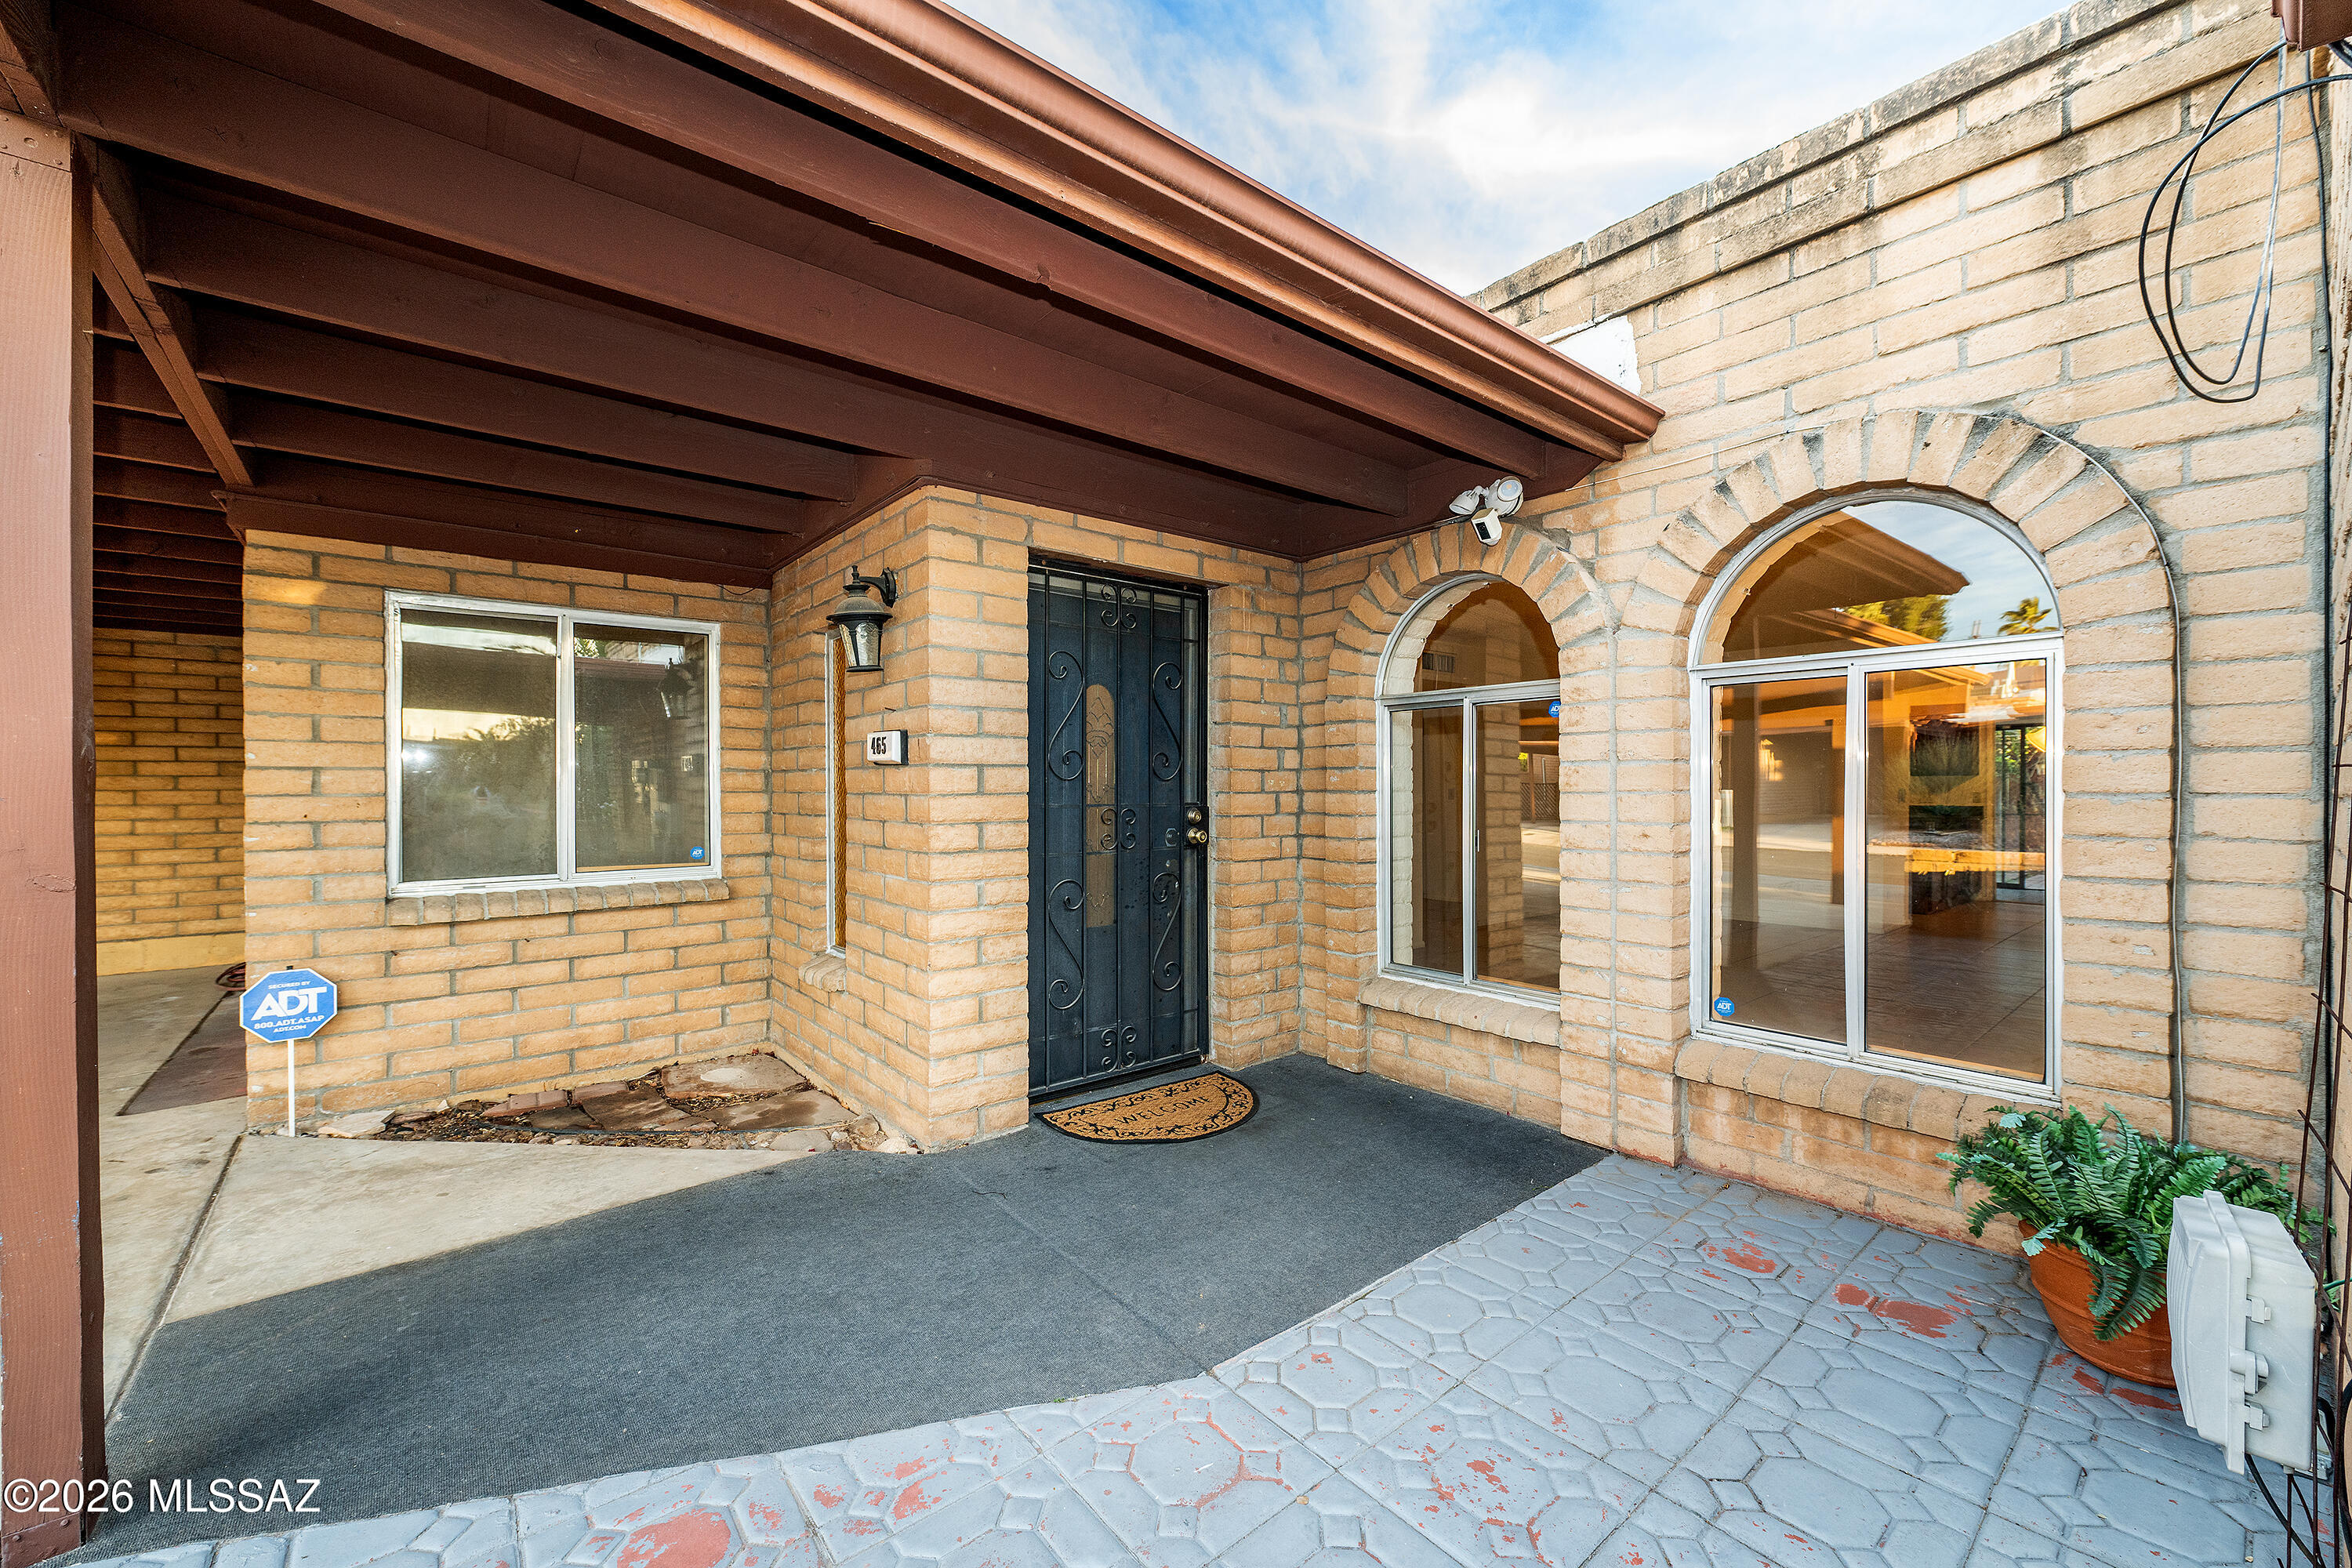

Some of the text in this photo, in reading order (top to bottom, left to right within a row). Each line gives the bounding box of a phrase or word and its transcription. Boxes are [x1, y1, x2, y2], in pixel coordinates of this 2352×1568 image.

[871, 736, 887, 754] 465
[251, 986, 327, 1021] ADT
[253, 1015, 325, 1029] 800.ADT.ASAP
[1114, 1095, 1212, 1124] WELCOME
